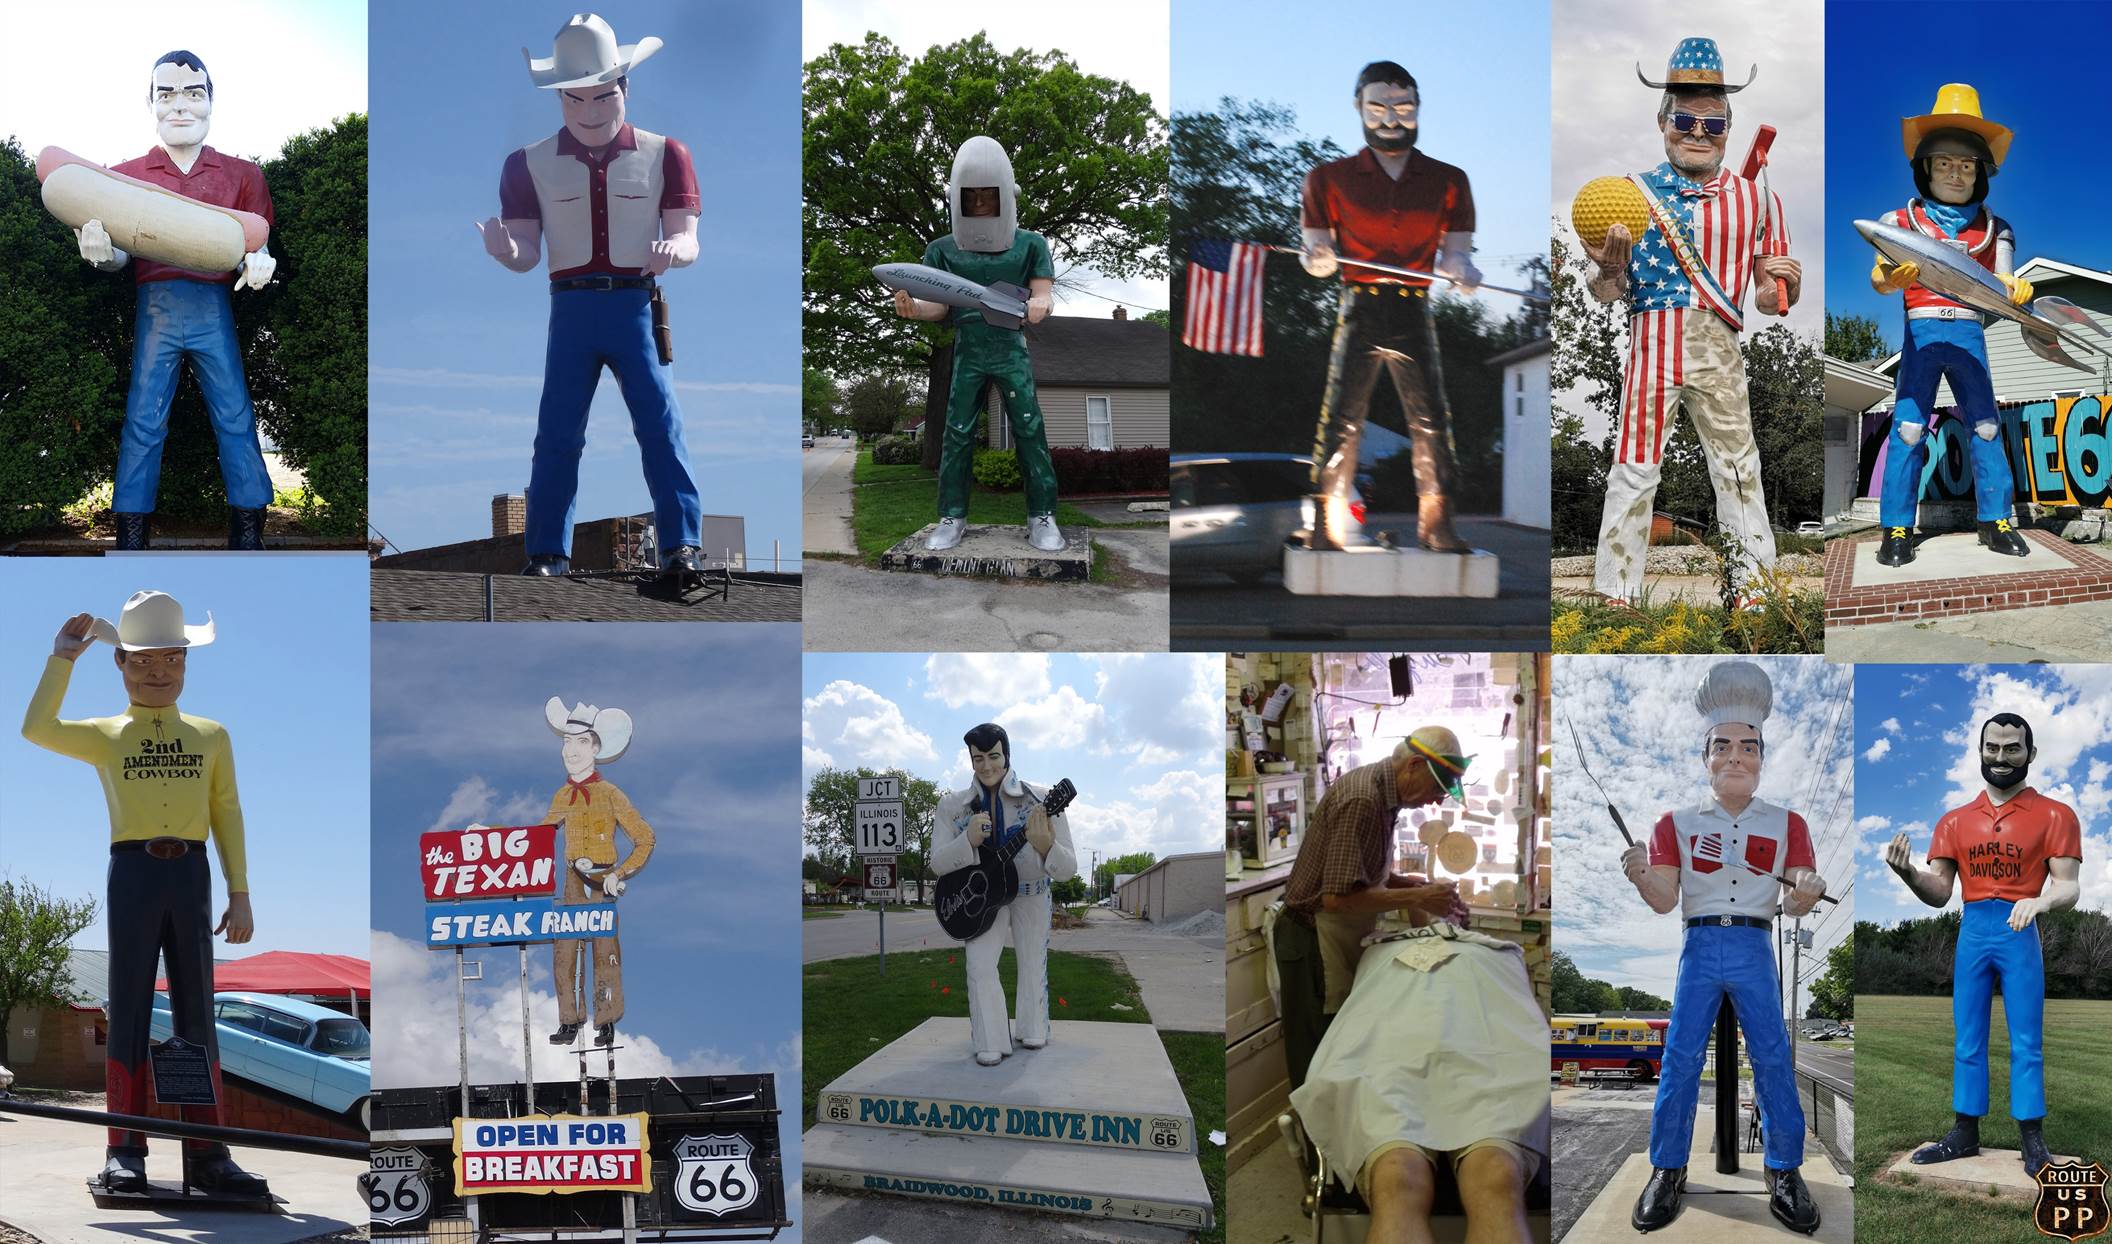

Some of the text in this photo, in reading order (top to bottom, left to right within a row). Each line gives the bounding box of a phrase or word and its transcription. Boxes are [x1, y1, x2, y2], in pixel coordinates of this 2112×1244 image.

[1650, 199, 1702, 276] MAYOR
[886, 269, 986, 300] Launching Pad
[1940, 308, 1953, 317] 66
[2063, 397, 2112, 495] 6
[912, 559, 922, 569] 66
[141, 738, 184, 755] 2nd
[123, 754, 204, 769] AMENDMENT
[123, 769, 203, 780] COWBOY
[866, 781, 892, 796] JCT
[860, 809, 898, 819] ILLINOIS
[862, 822, 897, 847] 113
[426, 829, 530, 866] the BIG
[1969, 841, 2023, 861] HARLEY
[433, 858, 552, 896] TEXAN
[1969, 862, 2021, 878] DAVIDSON
[873, 876, 887, 885] 66
[871, 889, 890, 897] ROUTE
[431, 910, 614, 941] STEAK RANCH
[830, 1107, 849, 1119] 66
[860, 1098, 1142, 1145] POLK-A-DOT DRIVE INN
[476, 1123, 626, 1147] OPEN FOR
[1154, 1133, 1177, 1146] 66
[688, 1144, 740, 1157] ROUTE
[465, 1154, 635, 1182] BREAKFAST
[689, 1163, 746, 1203] 66
[864, 1174, 1093, 1211] BRAIDWOOD, ILLINOIS
[370, 1174, 419, 1213] 66
